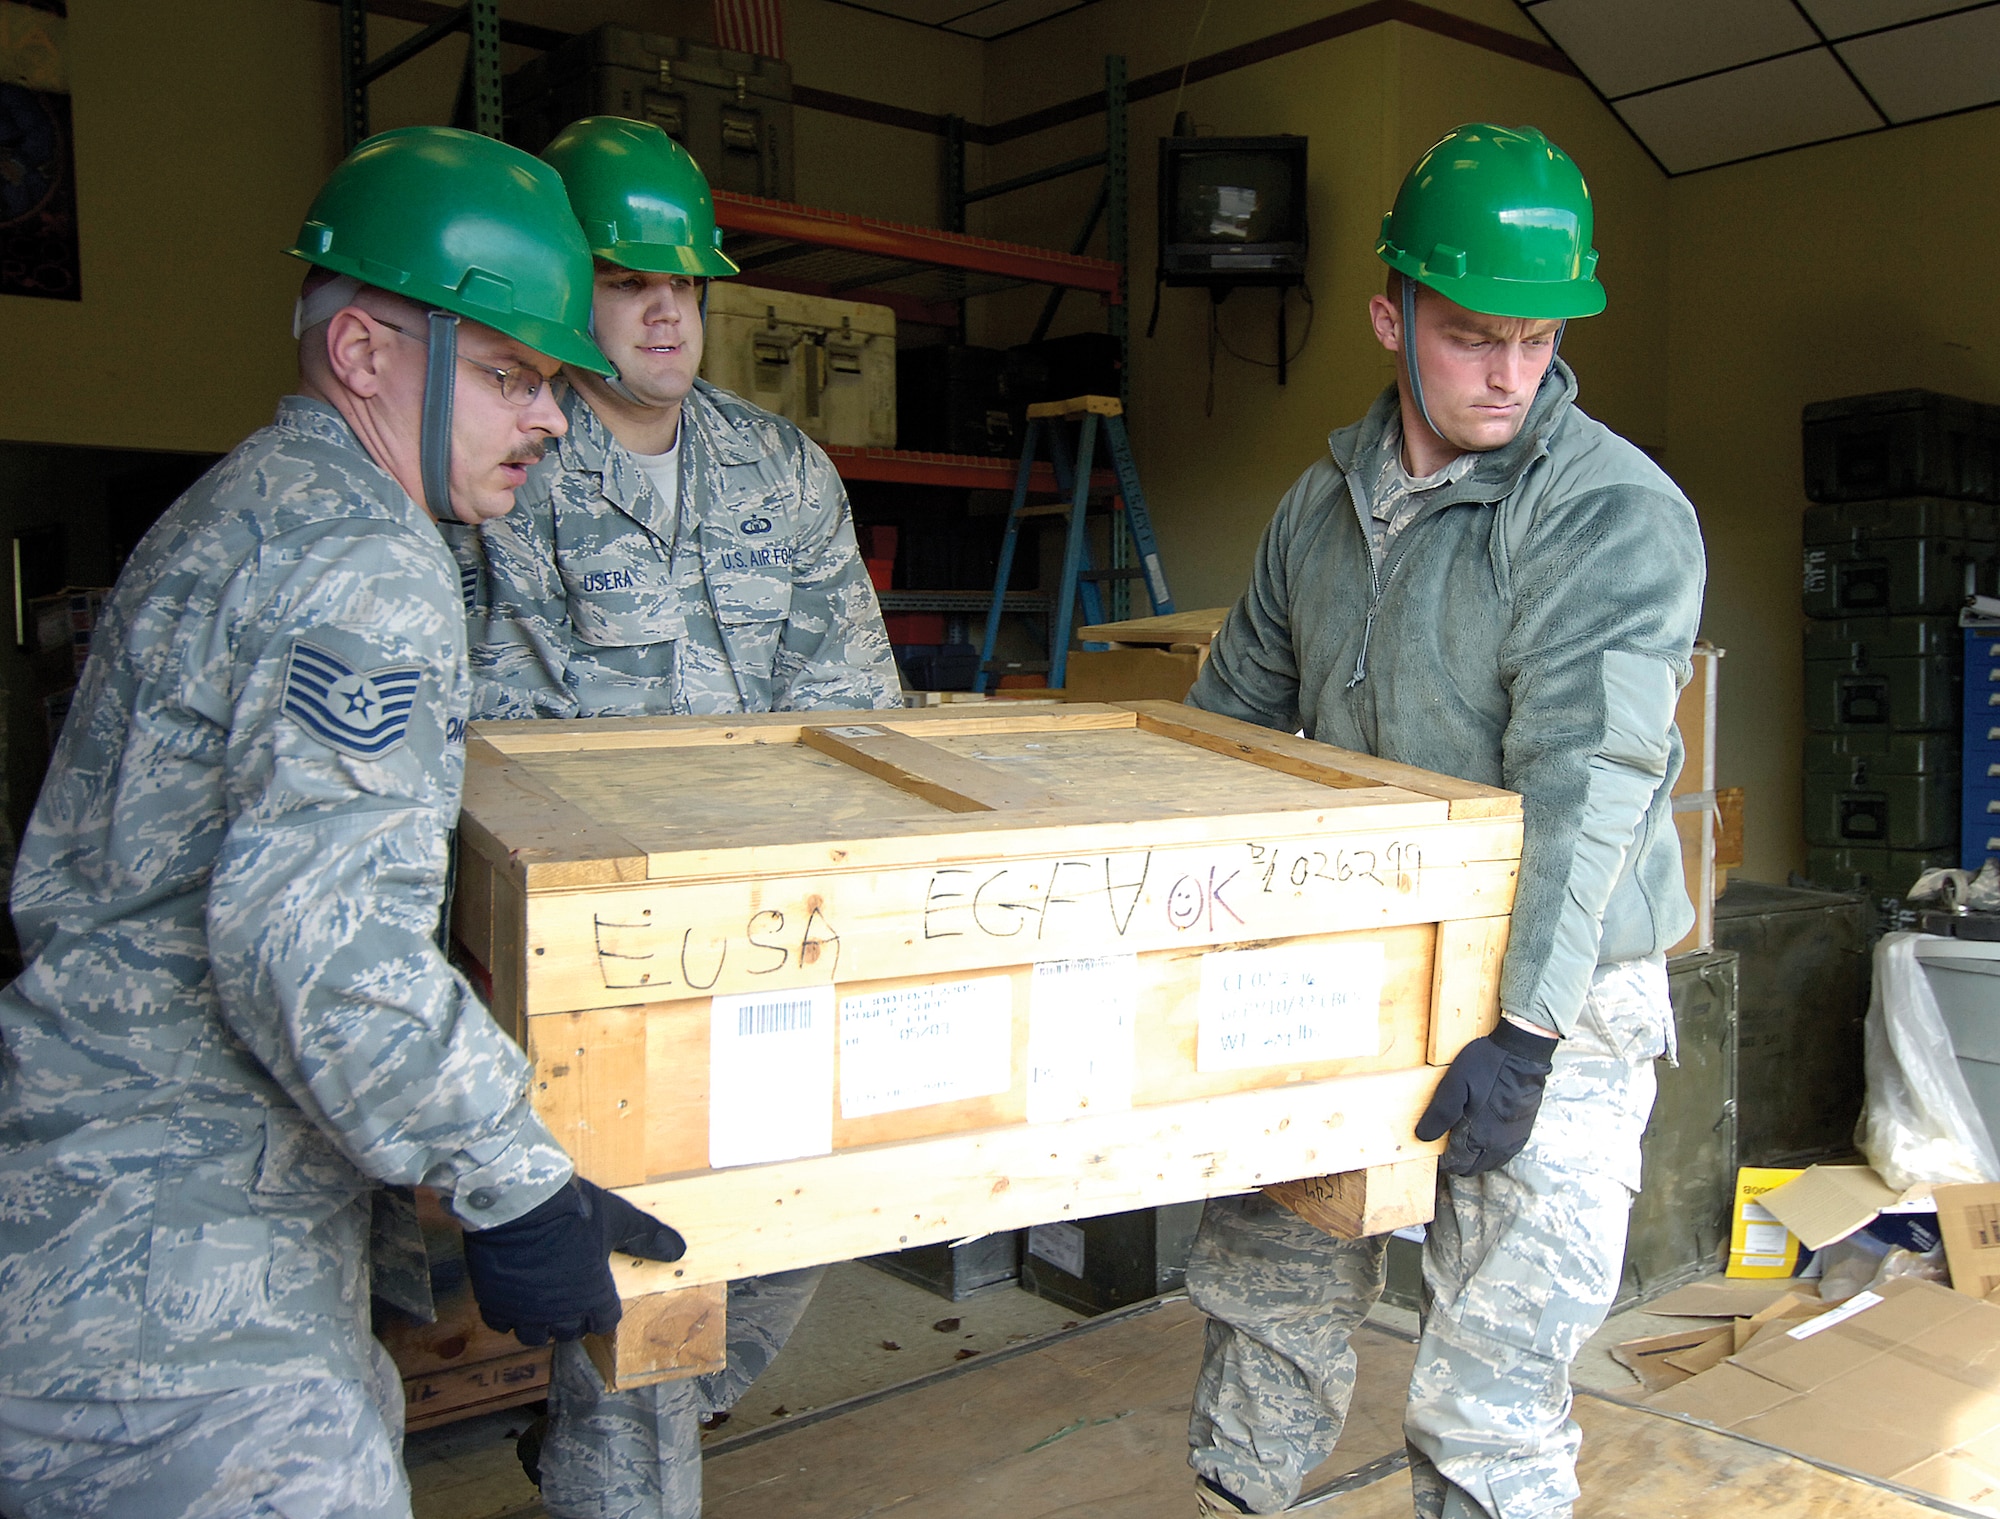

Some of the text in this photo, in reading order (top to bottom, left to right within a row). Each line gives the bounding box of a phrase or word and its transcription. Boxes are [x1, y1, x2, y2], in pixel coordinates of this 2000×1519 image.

[720, 551, 748, 570] U.S.
[750, 550, 771, 568] AIR
[583, 569, 633, 592] USERA
[1167, 864, 1246, 933] OK
